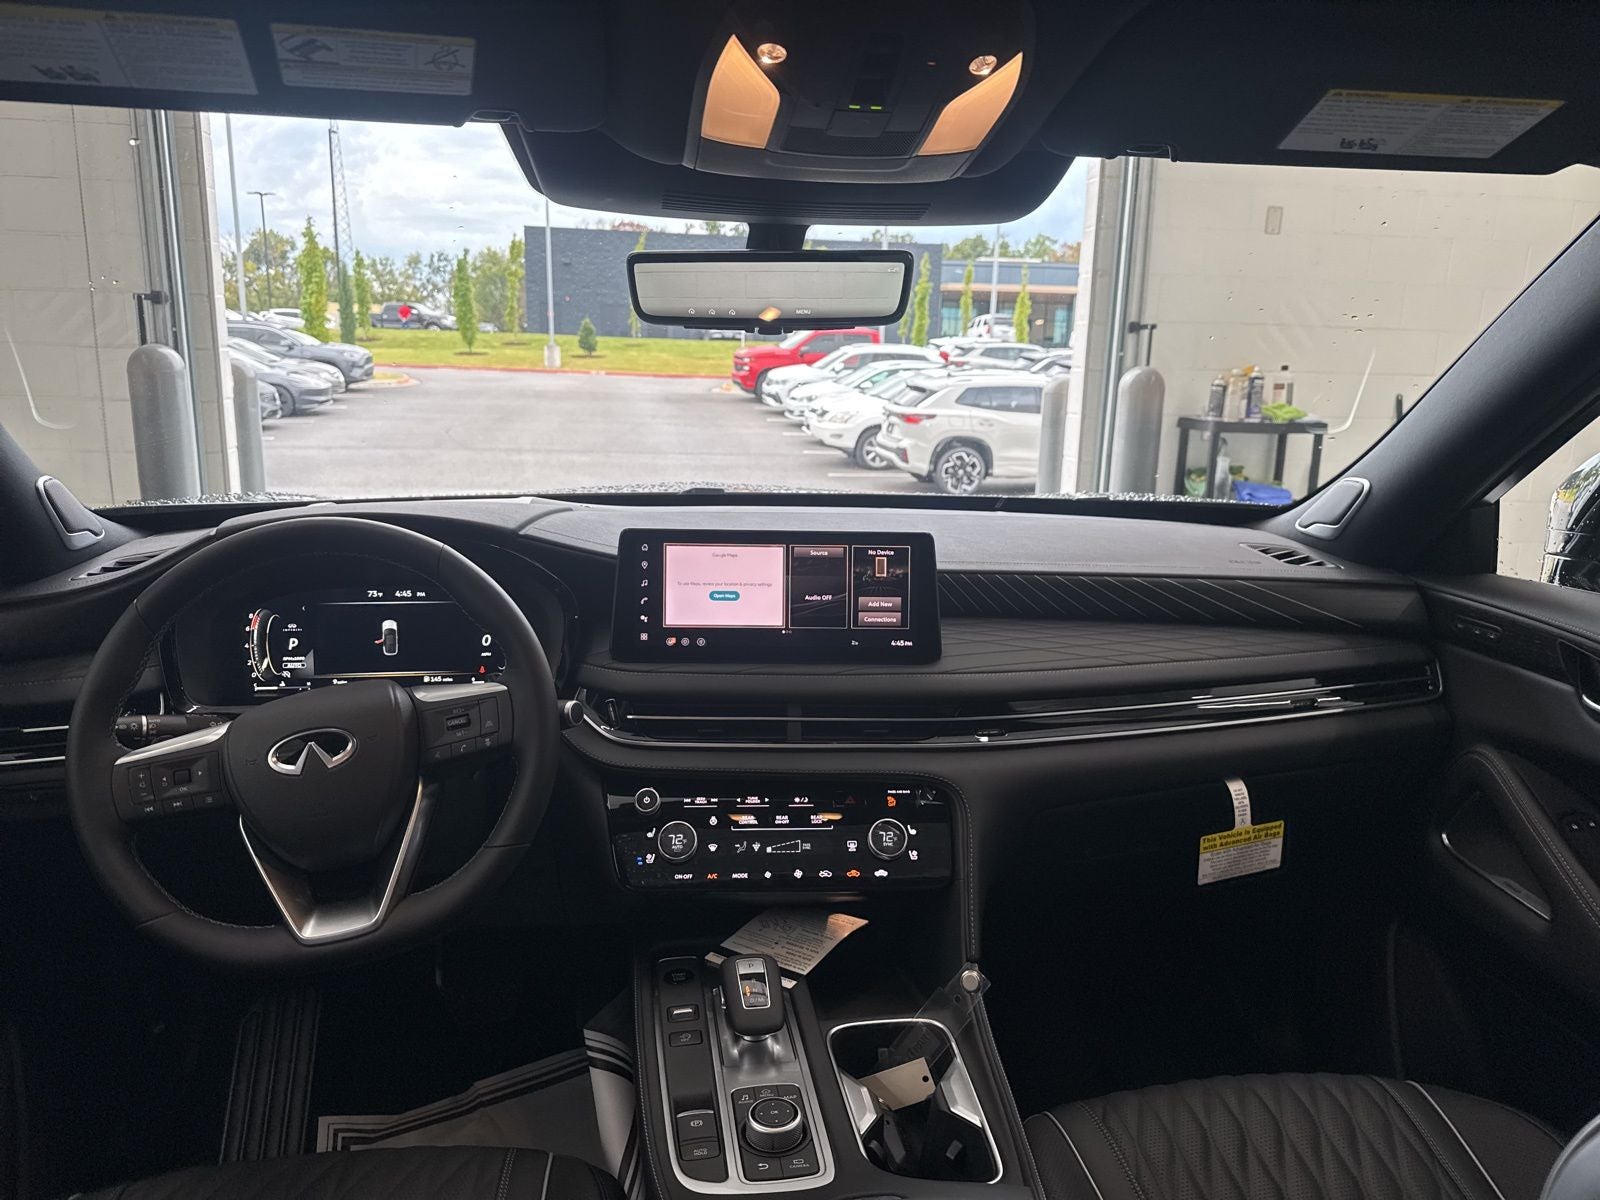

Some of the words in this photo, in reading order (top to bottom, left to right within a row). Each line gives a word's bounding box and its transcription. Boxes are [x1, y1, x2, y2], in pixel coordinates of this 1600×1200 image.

[288, 637, 299, 651] P
[481, 634, 492, 646] 0
[1202, 836, 1217, 844] This
[1218, 830, 1243, 841] Vehicle
[1251, 822, 1283, 835] Equipped
[1202, 842, 1218, 851] with
[1219, 835, 1252, 847] Advanced
[1253, 833, 1262, 841] Air
[1264, 830, 1281, 839] Bags
